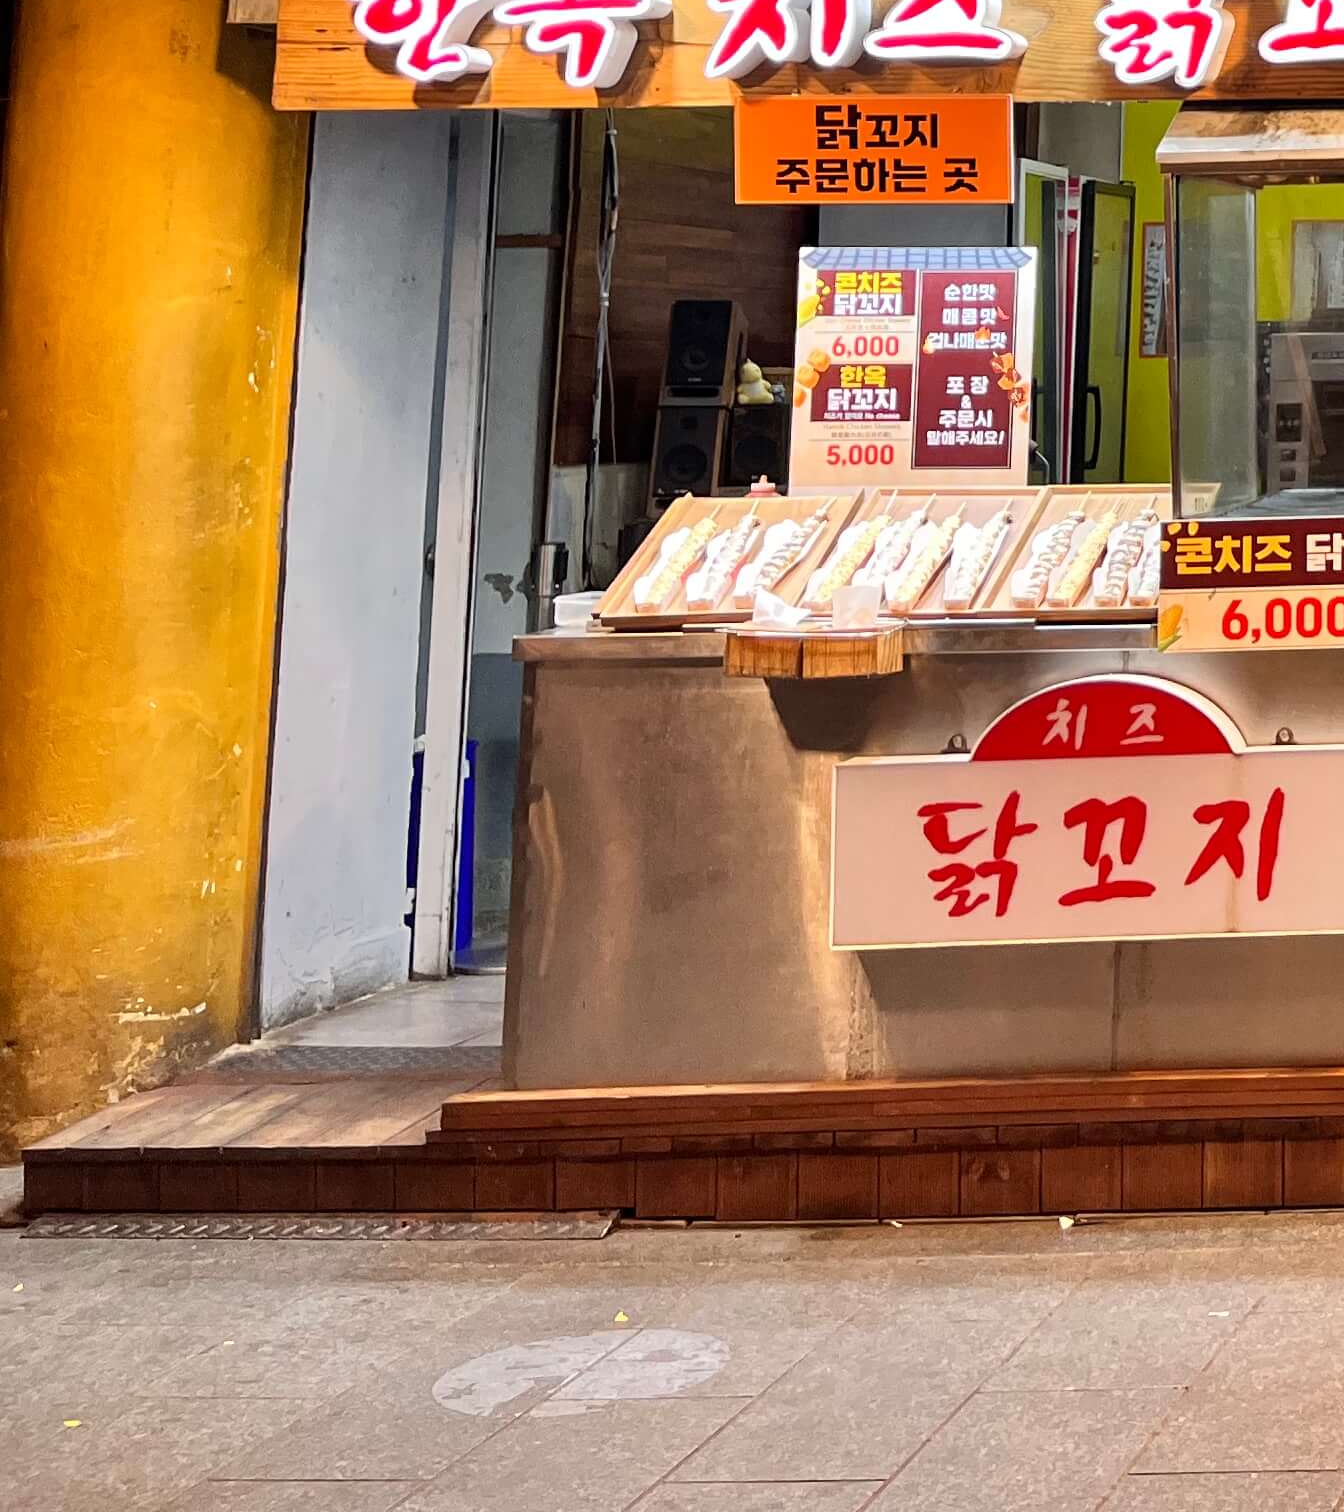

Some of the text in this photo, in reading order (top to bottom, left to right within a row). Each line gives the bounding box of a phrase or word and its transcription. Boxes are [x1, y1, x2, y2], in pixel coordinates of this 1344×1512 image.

[815, 104, 939, 150] 닭꼬지
[775, 157, 979, 194] 주문하는 곳
[831, 335, 900, 357] 6,000
[938, 408, 993, 429] 주문시
[826, 443, 895, 466] 5,000
[1175, 535, 1292, 576] 콘치즈
[1041, 697, 1164, 751] 치즈
[917, 786, 1285, 918] 닭꼬지
